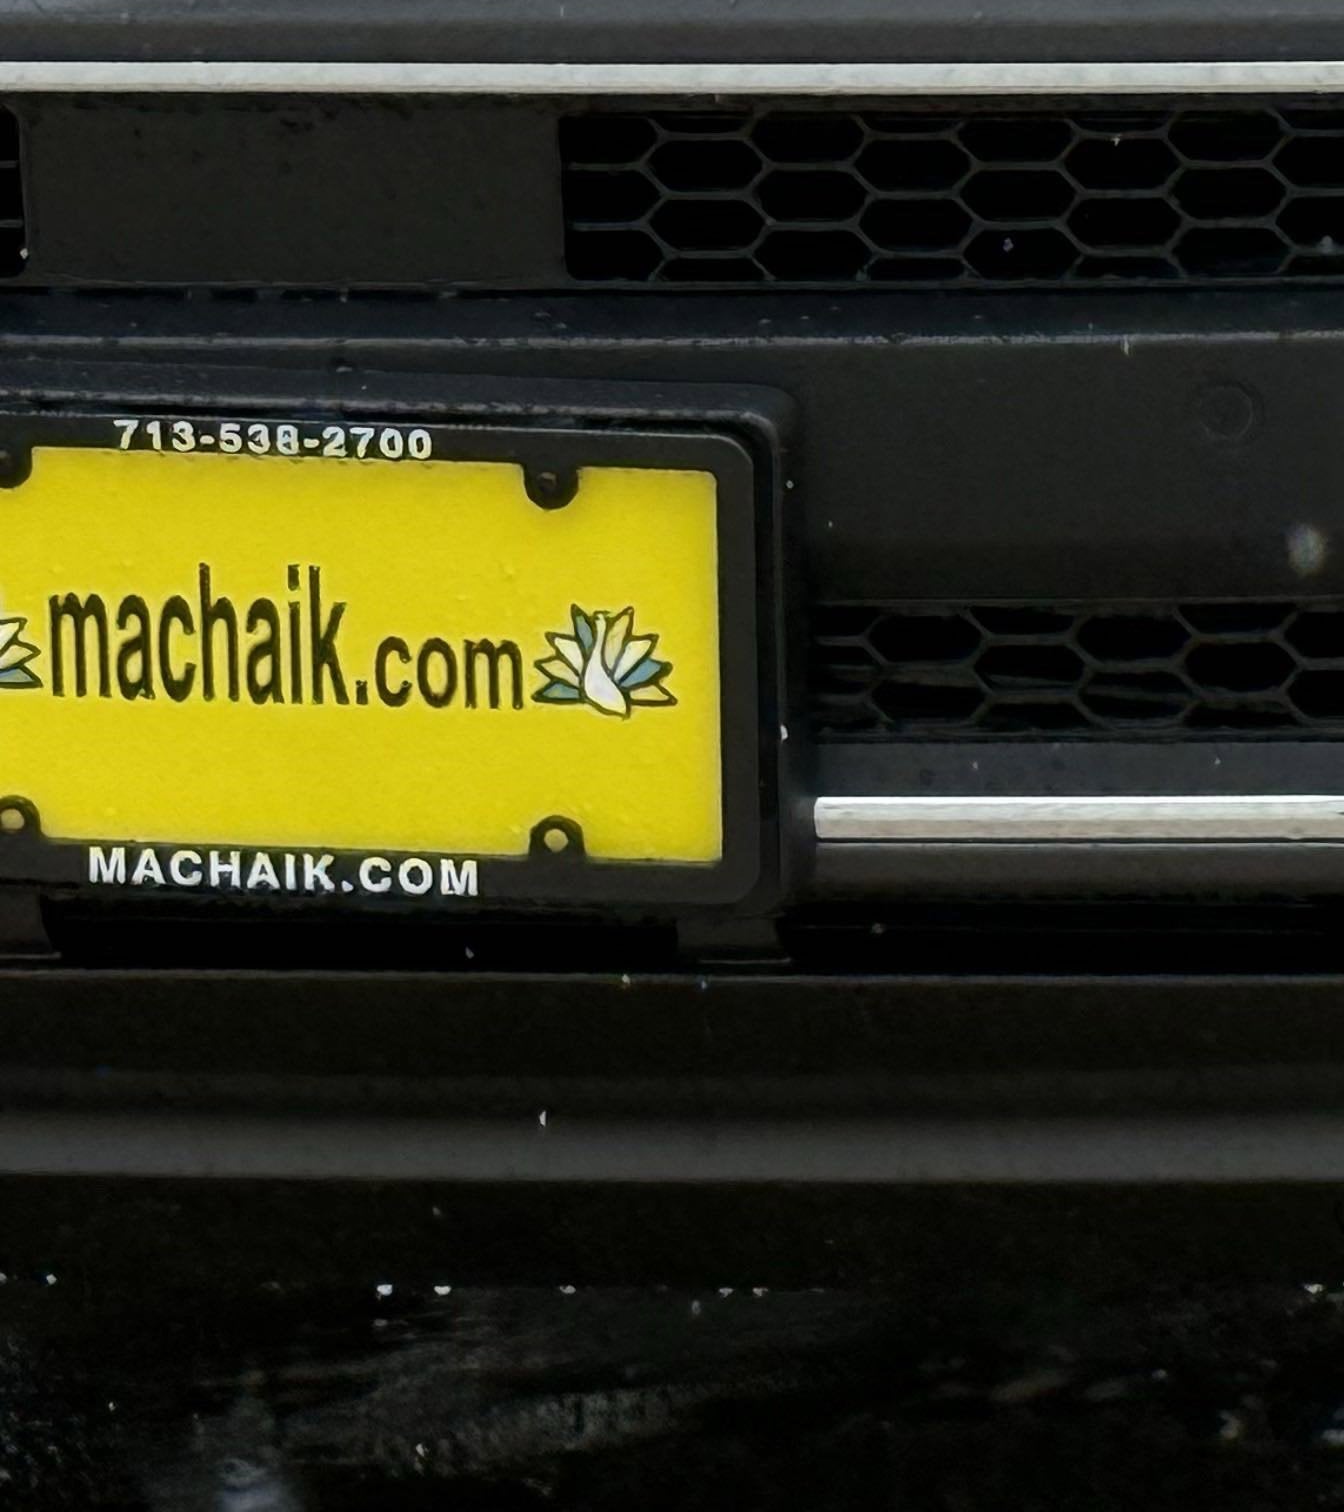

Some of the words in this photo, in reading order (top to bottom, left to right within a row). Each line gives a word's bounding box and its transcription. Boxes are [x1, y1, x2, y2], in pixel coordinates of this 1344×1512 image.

[113, 419, 433, 460] 713-538-2700
[48, 563, 525, 710] machaik.com
[88, 846, 479, 896] MACHAIK.COM
